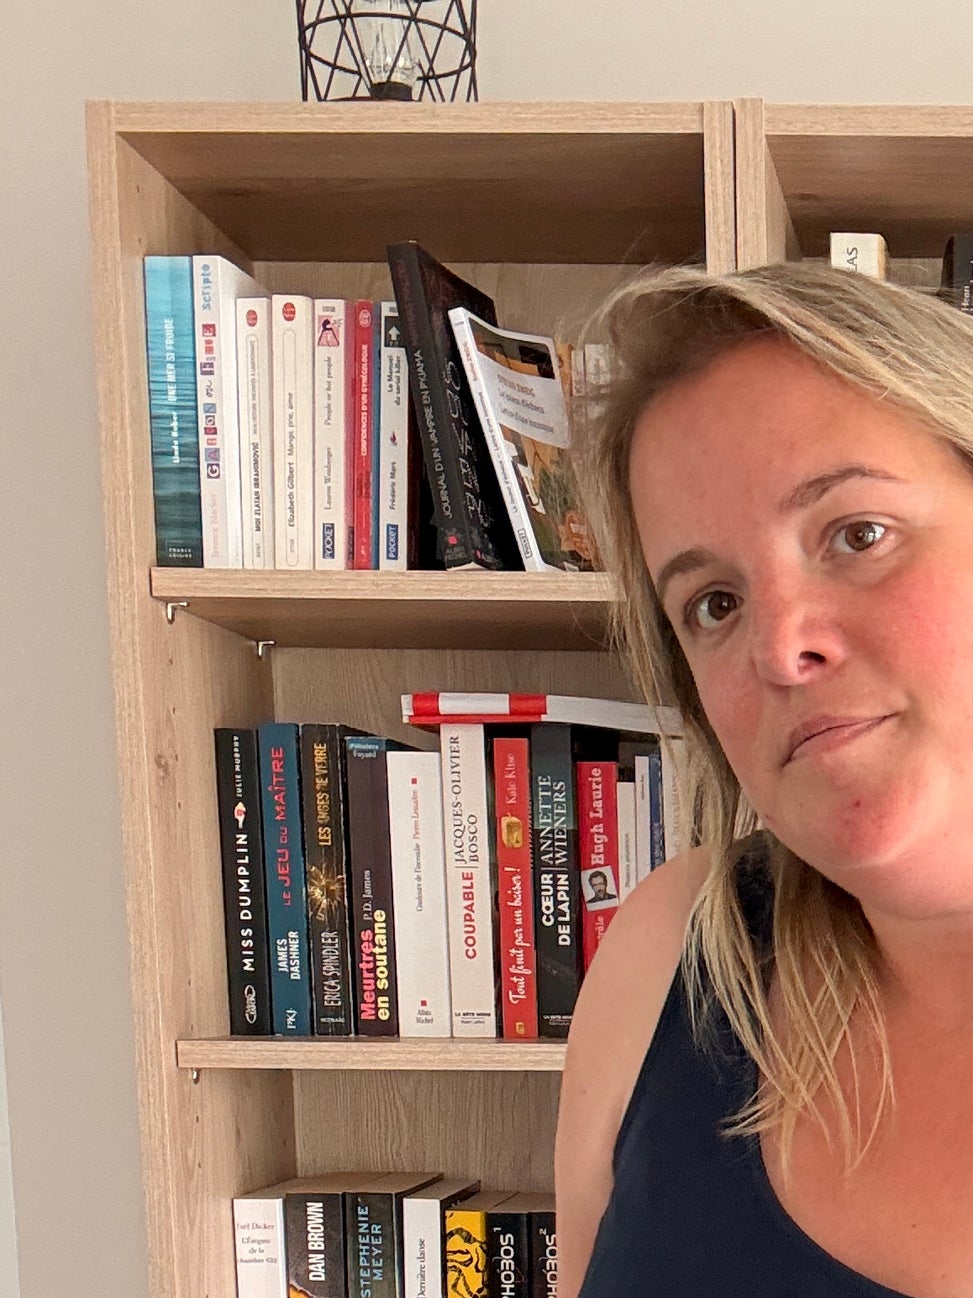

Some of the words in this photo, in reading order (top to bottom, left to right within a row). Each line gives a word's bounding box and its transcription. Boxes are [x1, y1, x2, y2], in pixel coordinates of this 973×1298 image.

[413, 350, 428, 389] PYJAMA
[421, 390, 432, 404] EN
[360, 411, 368, 456] CONFIDENCES
[425, 406, 441, 444] VAMPIRE
[432, 447, 446, 471] D'UN
[437, 473, 453, 519] JOURNAL
[233, 736, 242, 772] MURPHY
[267, 747, 287, 821] MAÎTRE
[448, 735, 467, 864] JACQUES-OLIVIER
[589, 768, 603, 818] Laurie
[467, 814, 480, 862] BOSCO
[538, 776, 555, 865] ANNETTE
[553, 781, 568, 864] WIENERS
[591, 824, 609, 865] Hugh
[235, 834, 253, 920] DUMPLIN
[276, 848, 291, 887] JEU
[362, 870, 373, 898] James
[283, 893, 291, 906] LE
[362, 901, 373, 921] P.D.
[508, 875, 524, 906] baiser
[541, 873, 555, 927] CŒUR
[556, 873, 571, 921] LAPIN
[461, 871, 478, 960] COUPABLE
[512, 909, 524, 925] un
[559, 924, 570, 945] DE
[241, 928, 255, 971] MISS
[277, 939, 289, 972] JAMES
[288, 931, 301, 979] DASHNER
[320, 931, 340, 977] SPINDLER
[371, 909, 389, 990] soutane
[511, 927, 529, 946] par
[358, 930, 377, 1020] Meurtres
[510, 948, 533, 974] finit
[324, 979, 342, 1006] ERICA
[375, 996, 390, 1020] en
[508, 978, 526, 1004] Tout
[307, 1201, 325, 1250] BROWN
[309, 1254, 326, 1281] DAN
[358, 1206, 371, 1298] STEPHENIE
[371, 1223, 383, 1280] MEYER
